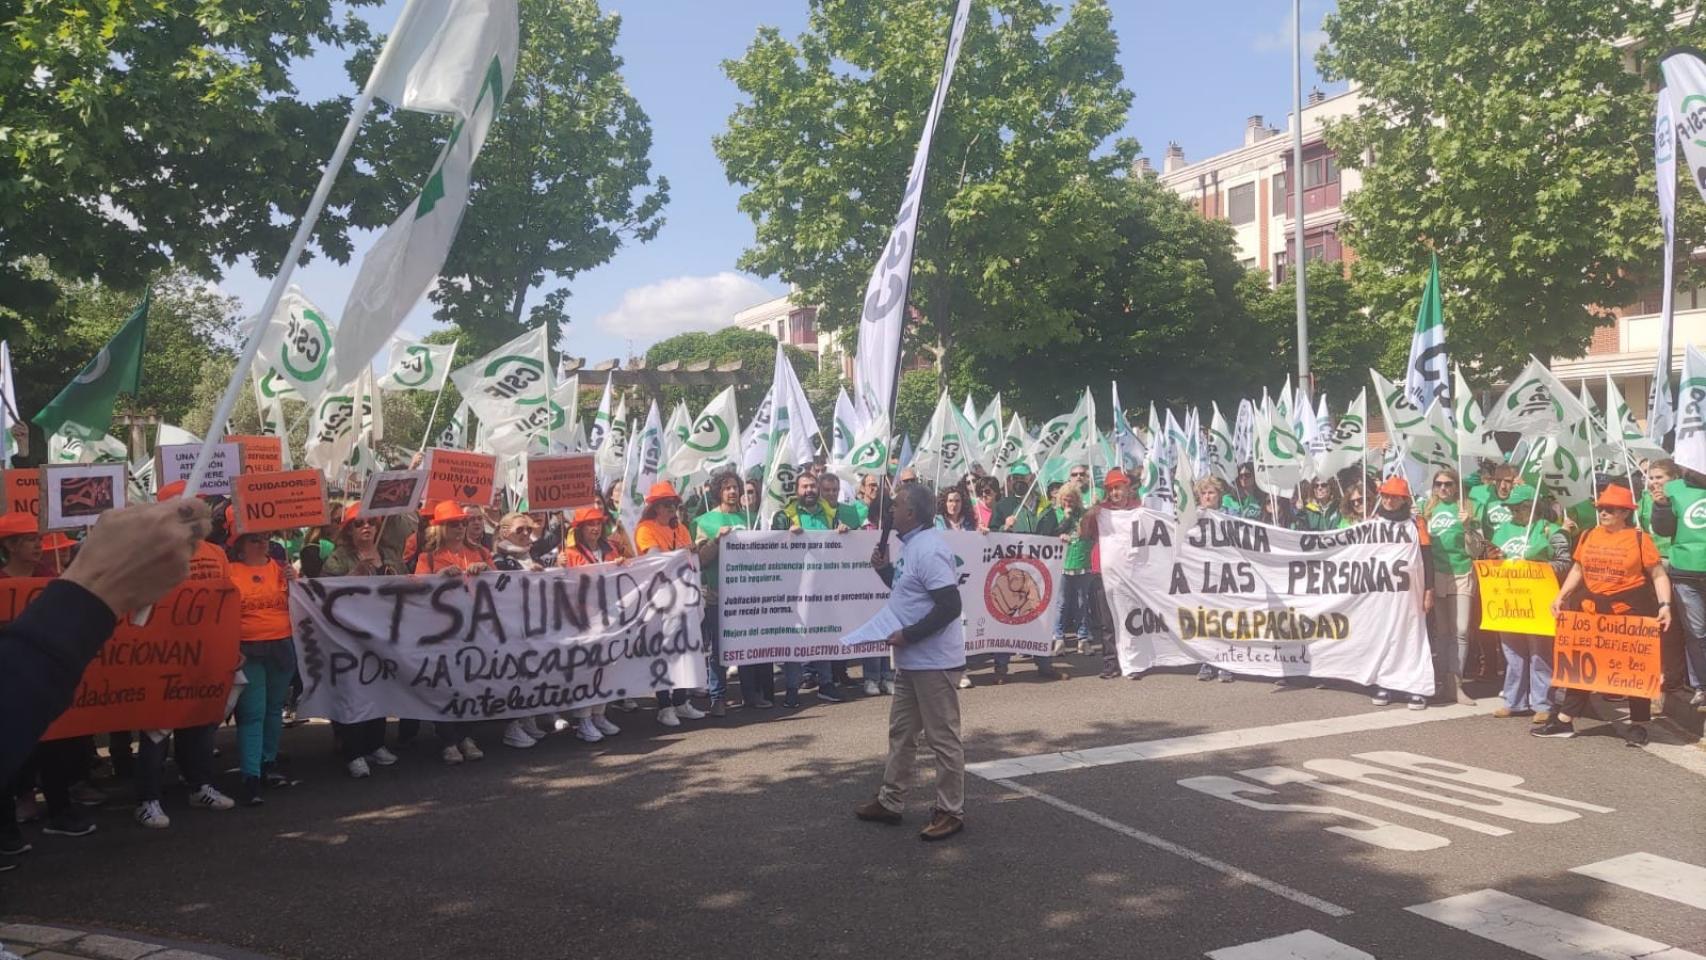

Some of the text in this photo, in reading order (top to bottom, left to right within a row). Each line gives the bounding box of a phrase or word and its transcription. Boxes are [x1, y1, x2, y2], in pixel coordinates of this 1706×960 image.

[176, 453, 195, 461] UNA
[433, 472, 494, 486] FORMACIÓN
[453, 484, 461, 497] Y
[535, 485, 561, 502] NO
[246, 502, 275, 520] NO
[1131, 520, 1171, 548] LA
[1189, 518, 1270, 552] JUNTA
[1169, 557, 1410, 594] A LAS PERSONAS
[520, 564, 702, 638] UNIDOS
[1487, 598, 1535, 620] Calidad
[724, 607, 737, 617] que
[1125, 607, 1170, 636] CON
[1557, 613, 1567, 628] A
[1572, 614, 1591, 631] los
[723, 628, 748, 638] Mejora
[723, 651, 745, 662] ESTE
[747, 647, 791, 660] CONVENIO
[794, 644, 839, 657] COLECTIVO
[841, 644, 851, 655] ES
[985, 638, 1048, 652] TRABAJADORES
[1214, 644, 1310, 664] intelectual
[1573, 634, 1592, 647] LES
[1595, 635, 1652, 655] DEFIENDE
[330, 650, 399, 686] POR
[411, 655, 453, 687] LA
[1556, 650, 1597, 684] NO
